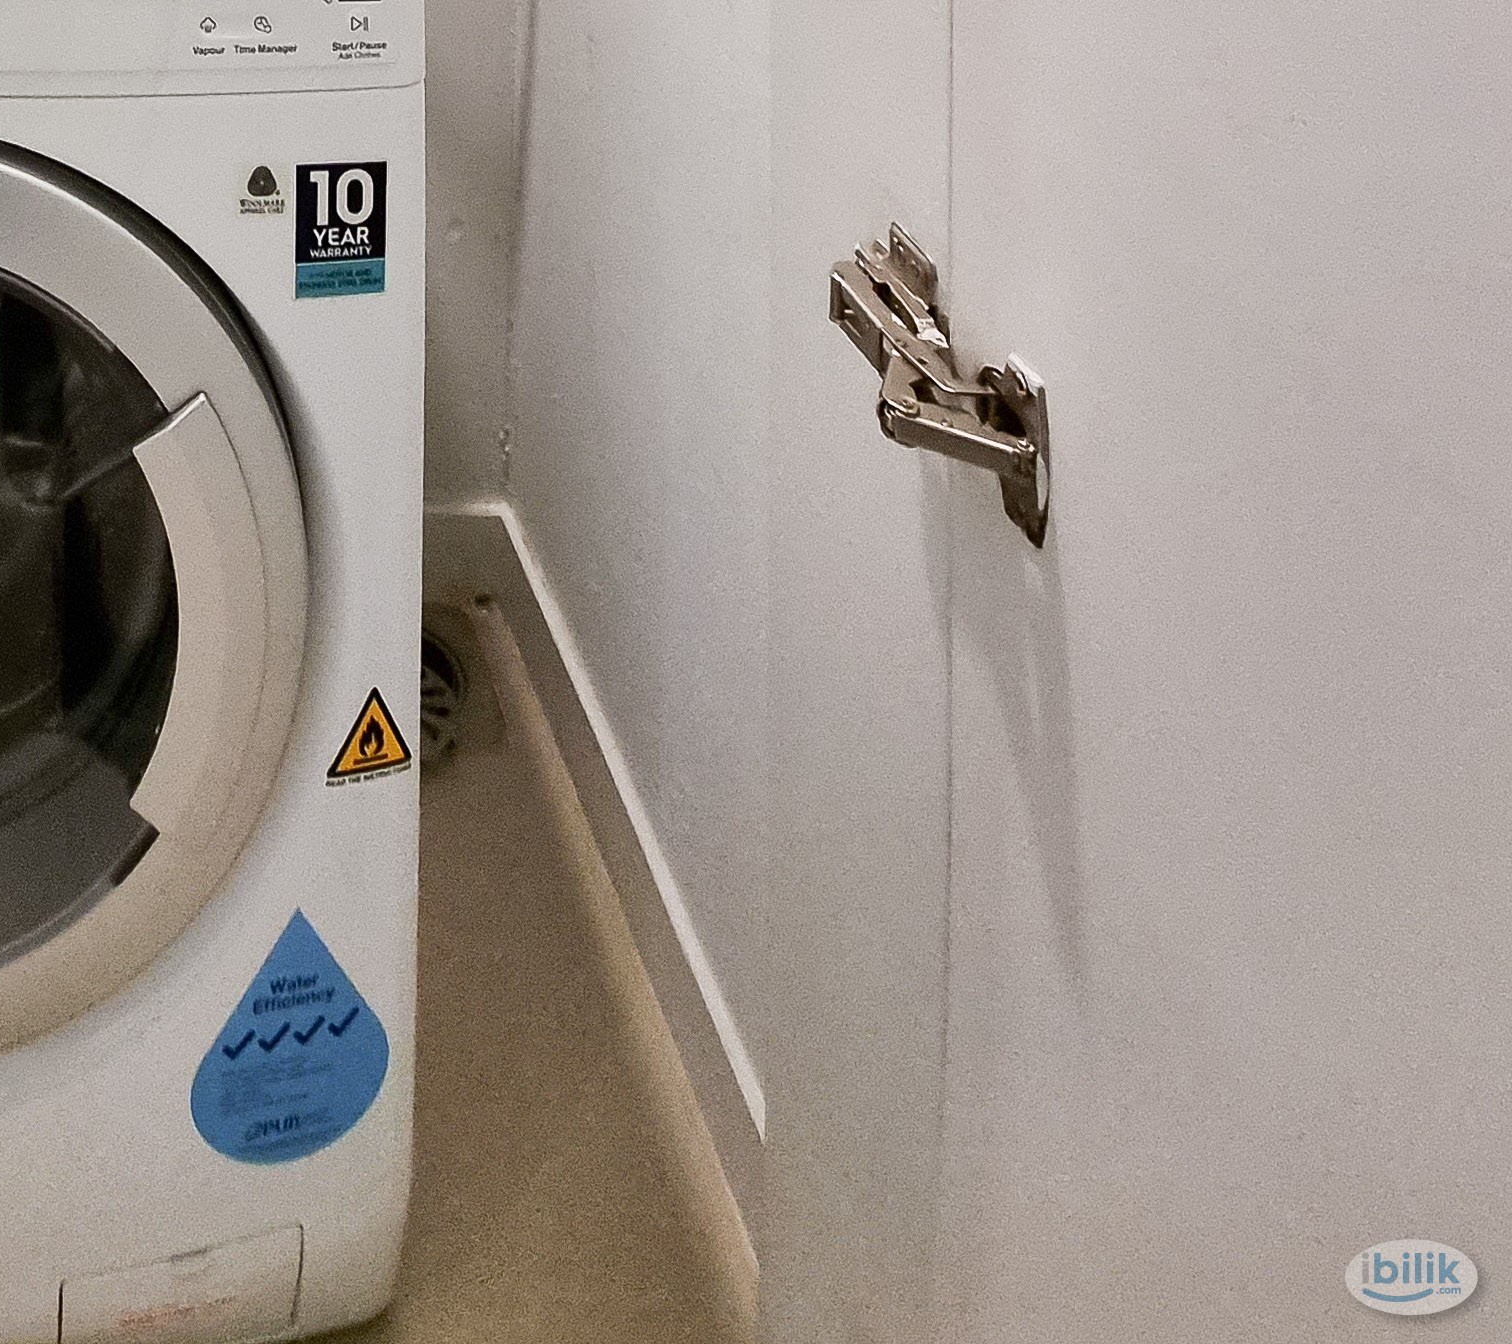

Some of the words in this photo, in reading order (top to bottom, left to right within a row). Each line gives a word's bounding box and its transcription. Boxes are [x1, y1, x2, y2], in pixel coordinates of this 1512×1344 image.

[192, 45, 226, 56] Vapour
[234, 45, 256, 54] Time
[257, 44, 298, 55] Manager
[331, 41, 387, 52] Start/Pause
[309, 168, 374, 226] 10
[313, 226, 370, 247] YEAR
[309, 245, 373, 259] WARRANTY
[269, 974, 319, 995] Water
[252, 987, 336, 1016] Efficiency
